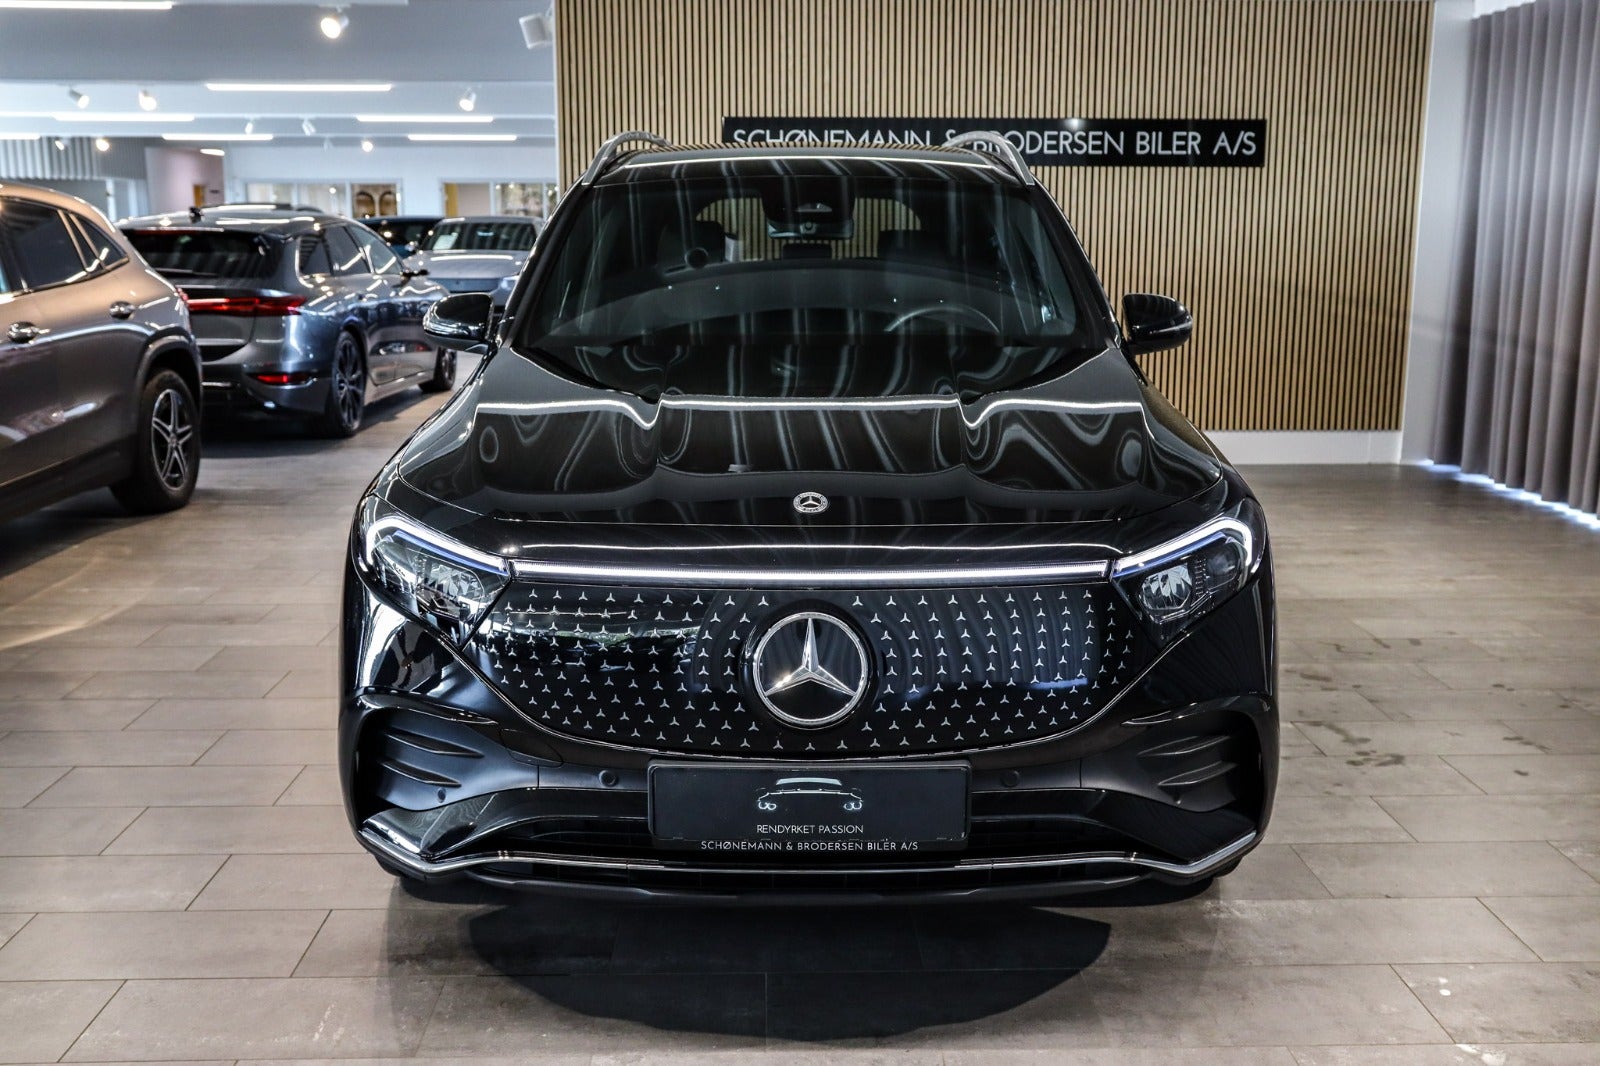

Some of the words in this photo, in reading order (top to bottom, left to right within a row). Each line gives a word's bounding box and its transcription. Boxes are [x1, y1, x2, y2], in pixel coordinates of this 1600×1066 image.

[1136, 131, 1201, 155] BILER
[1212, 130, 1257, 156] A/S
[756, 824, 816, 834] RENDYRKET
[818, 824, 864, 834] PASSION
[700, 840, 782, 851] SCHØNEMANN
[785, 841, 793, 851] &
[797, 841, 863, 851] BRODERSEN
[867, 841, 897, 851] BILER
[900, 841, 919, 851] A/S
